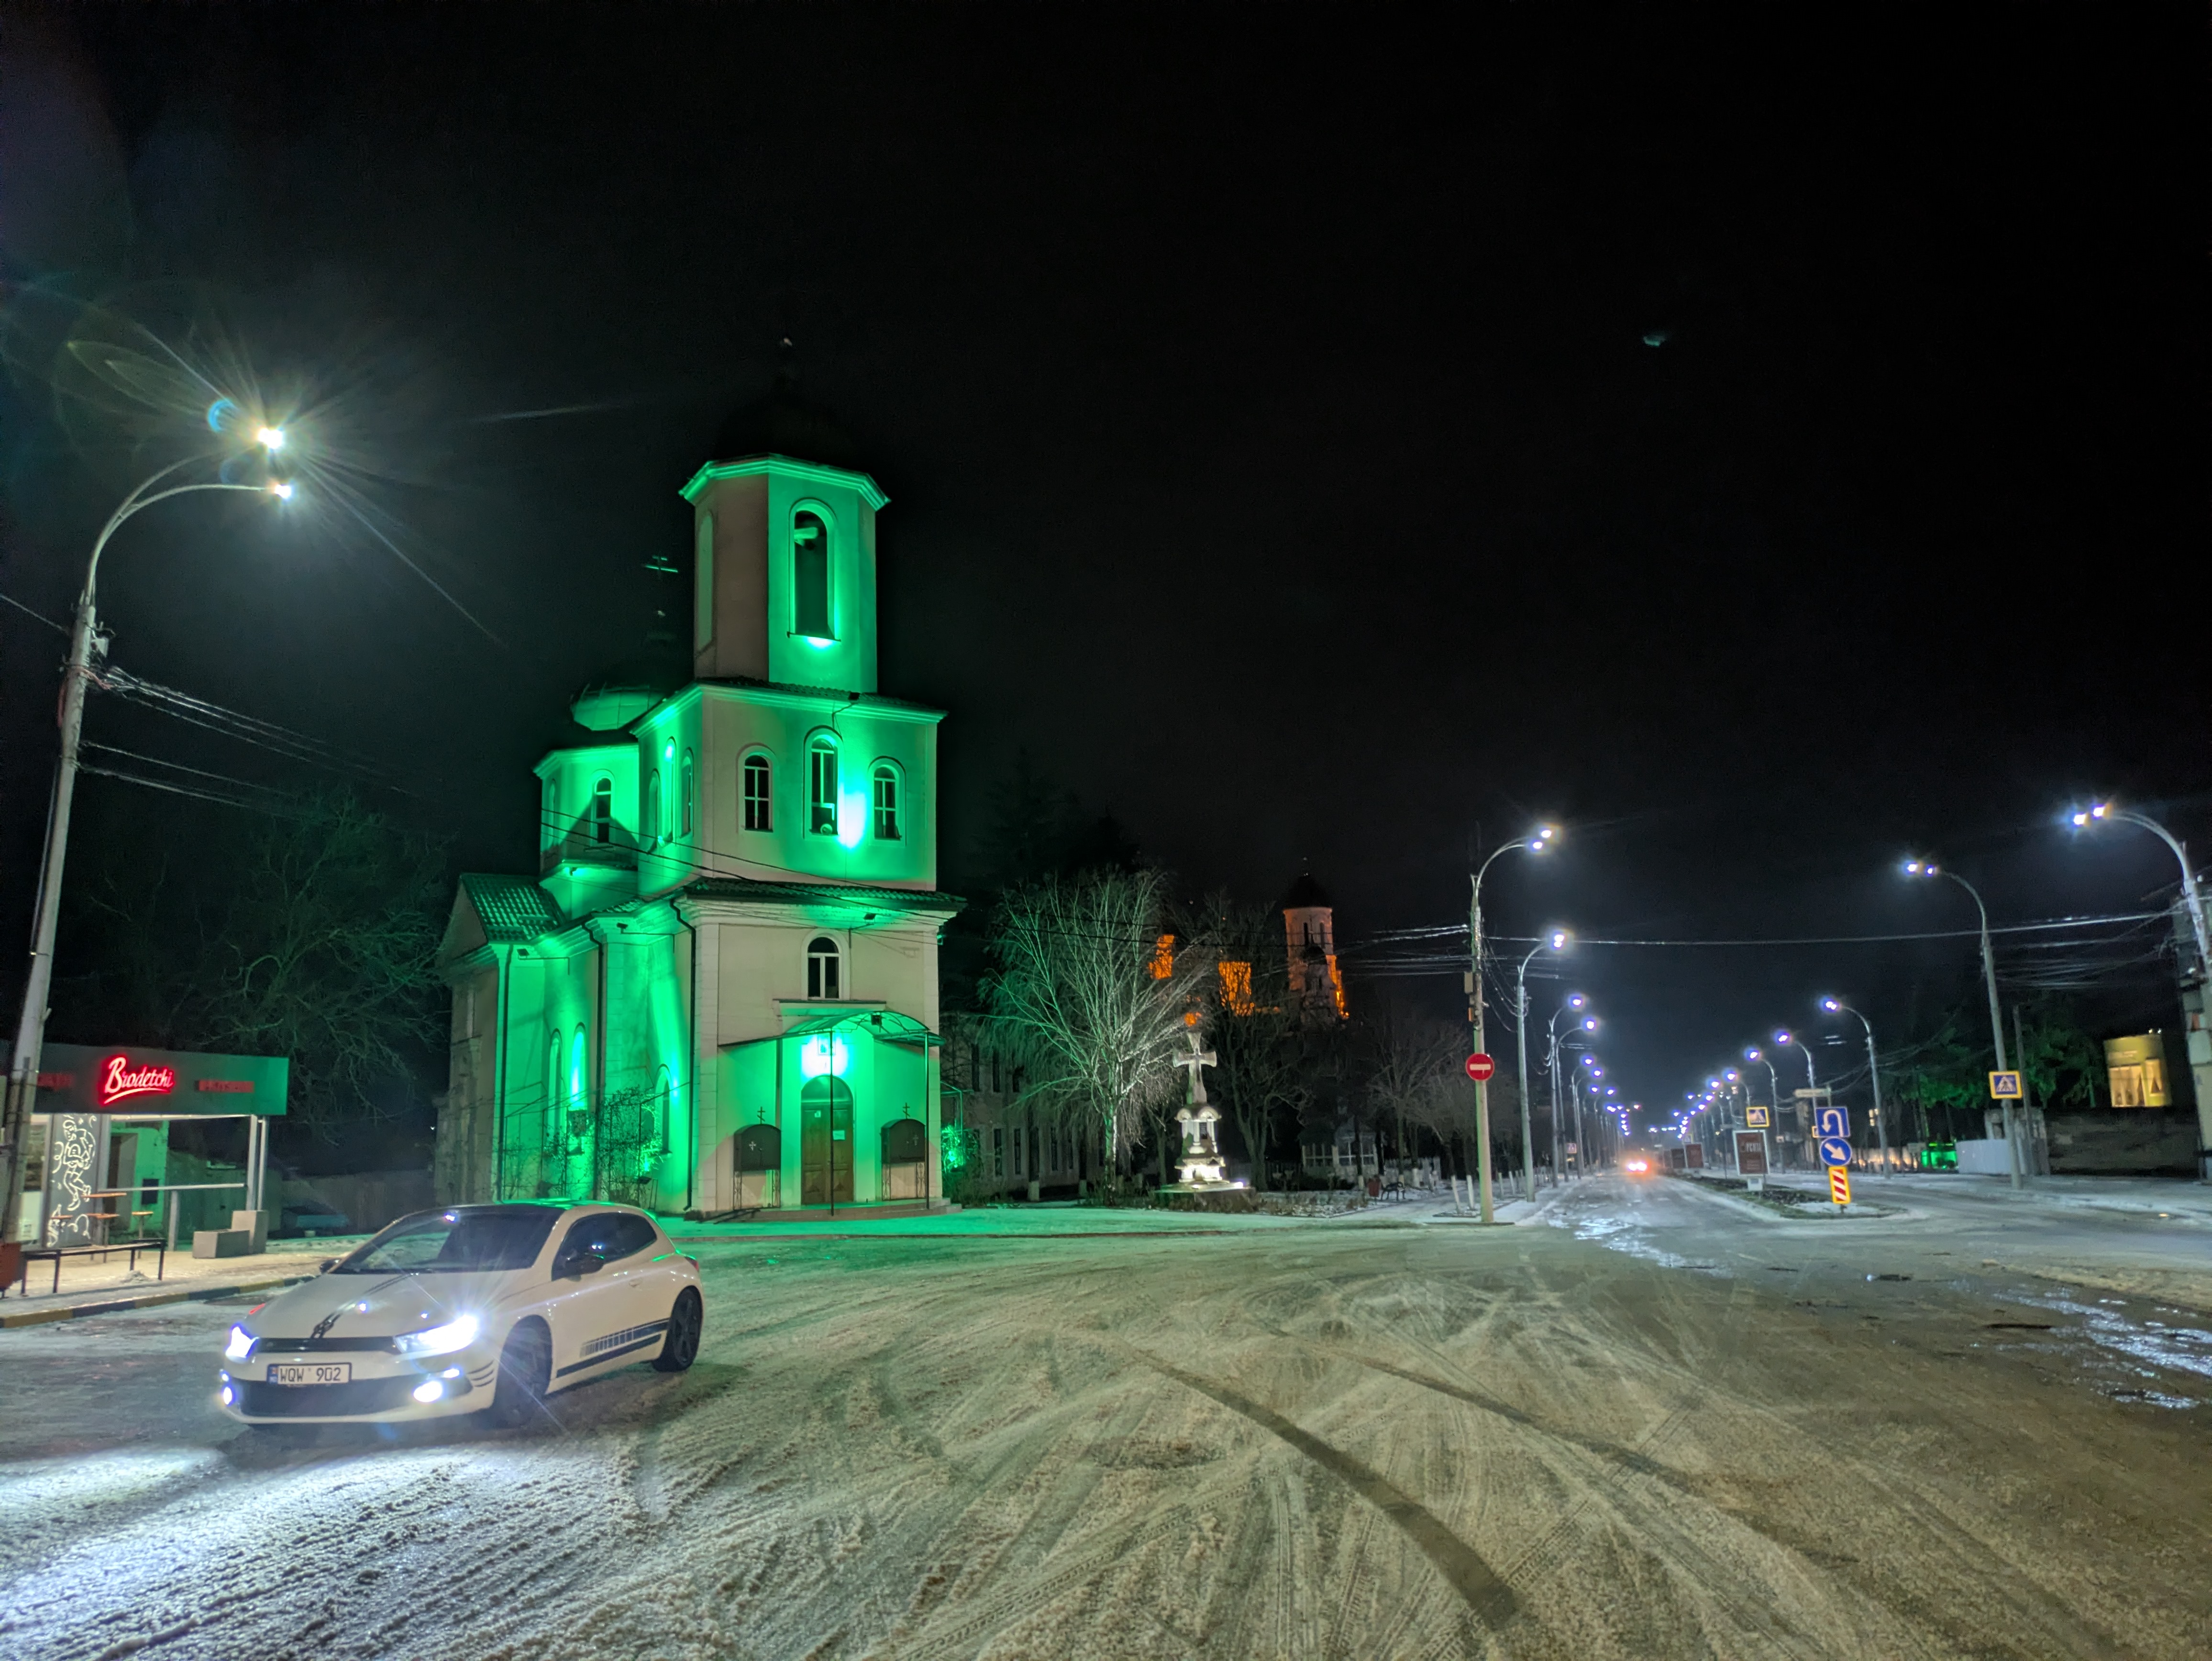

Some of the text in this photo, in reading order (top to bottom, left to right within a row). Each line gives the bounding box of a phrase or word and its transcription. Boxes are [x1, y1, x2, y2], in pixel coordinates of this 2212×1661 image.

[104, 1057, 174, 1094] Brodetchi
[280, 1368, 304, 1382] WQW
[316, 1367, 341, 1382] 902
